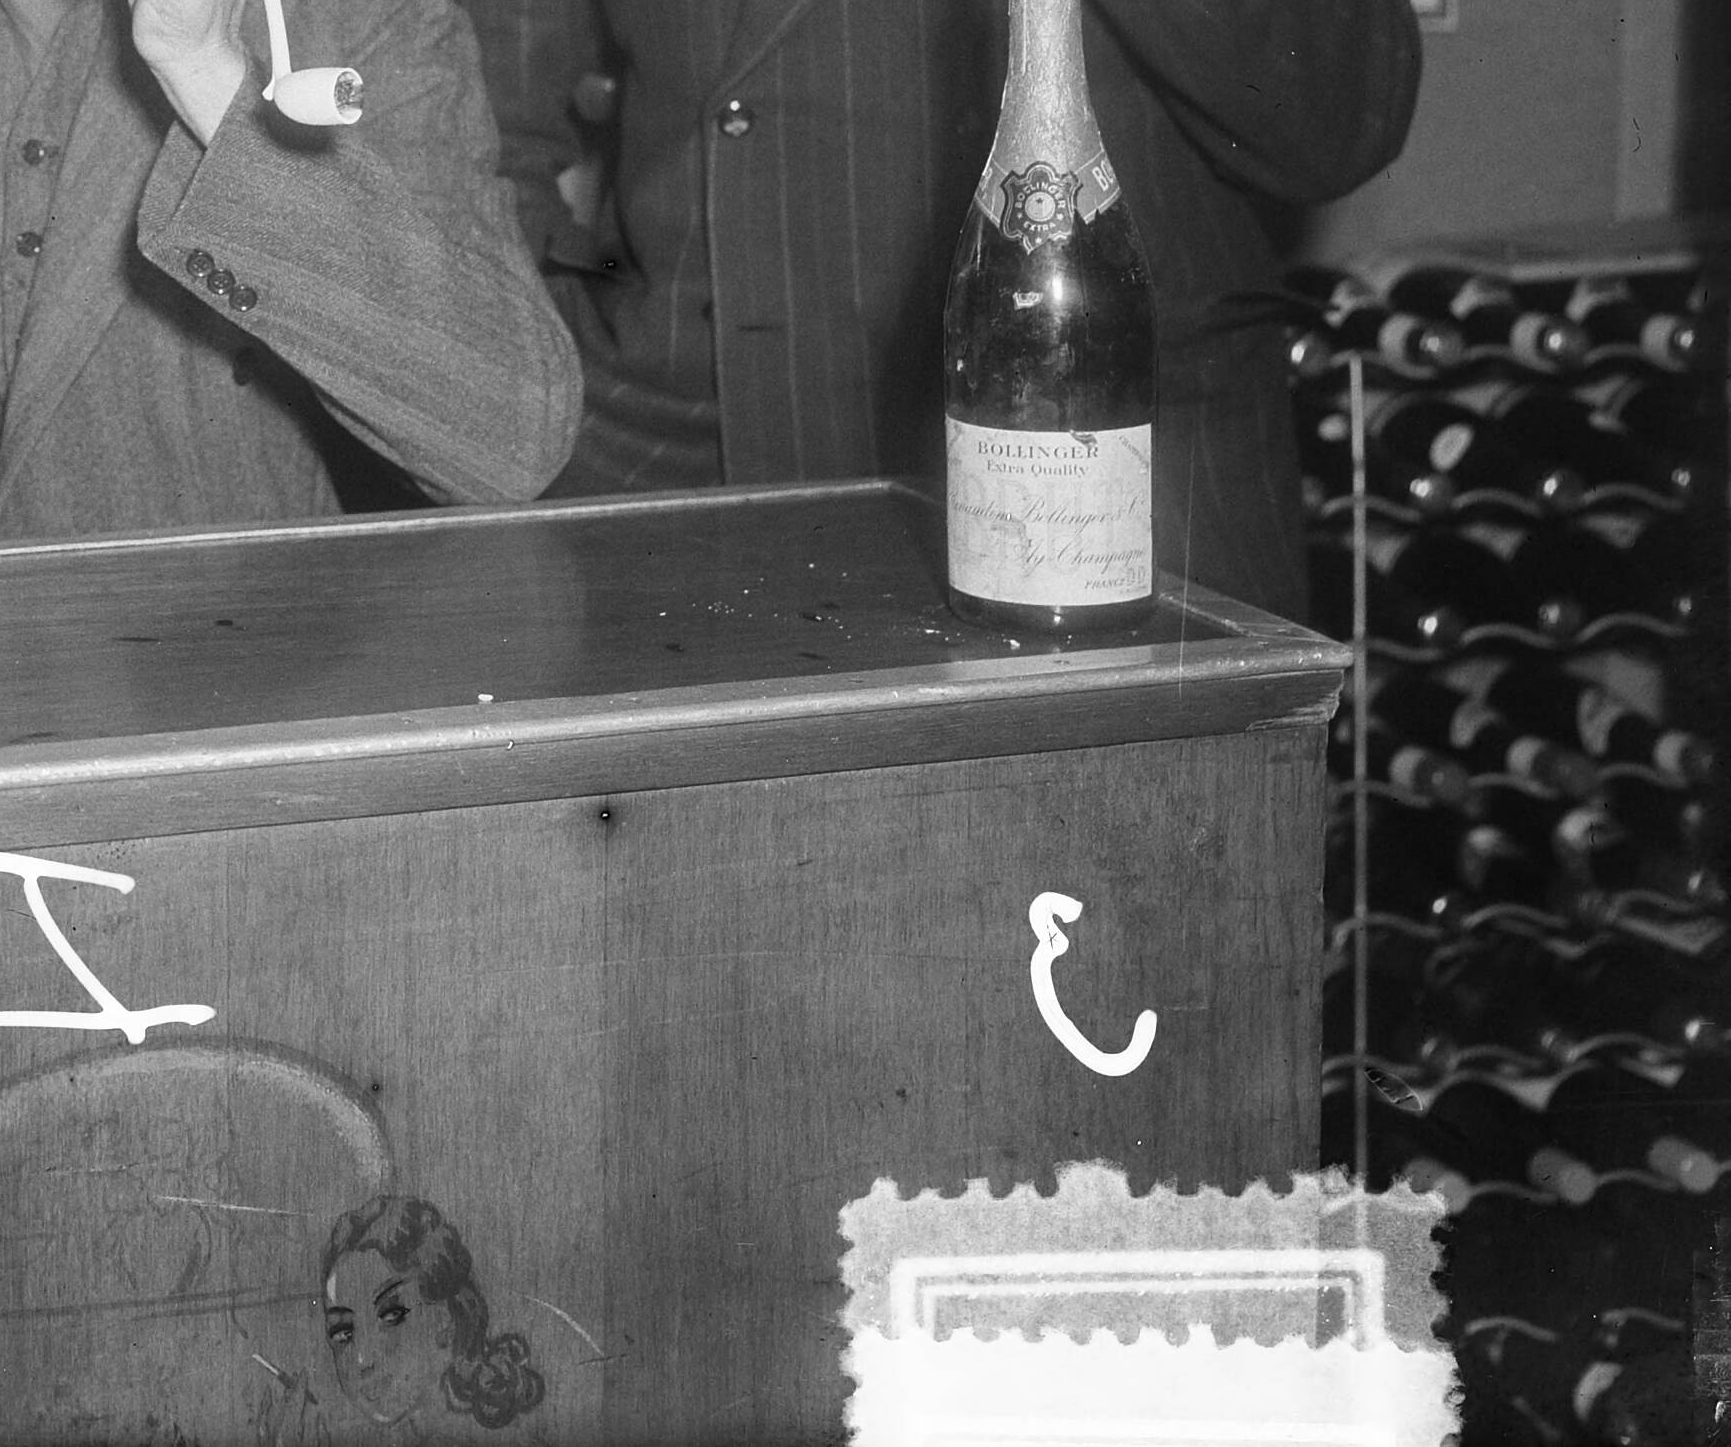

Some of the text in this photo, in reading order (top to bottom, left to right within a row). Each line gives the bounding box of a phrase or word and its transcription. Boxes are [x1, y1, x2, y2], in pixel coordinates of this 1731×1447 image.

[976, 440, 1099, 460] BOLLINGER
[986, 459, 1090, 478] Extra Quality
